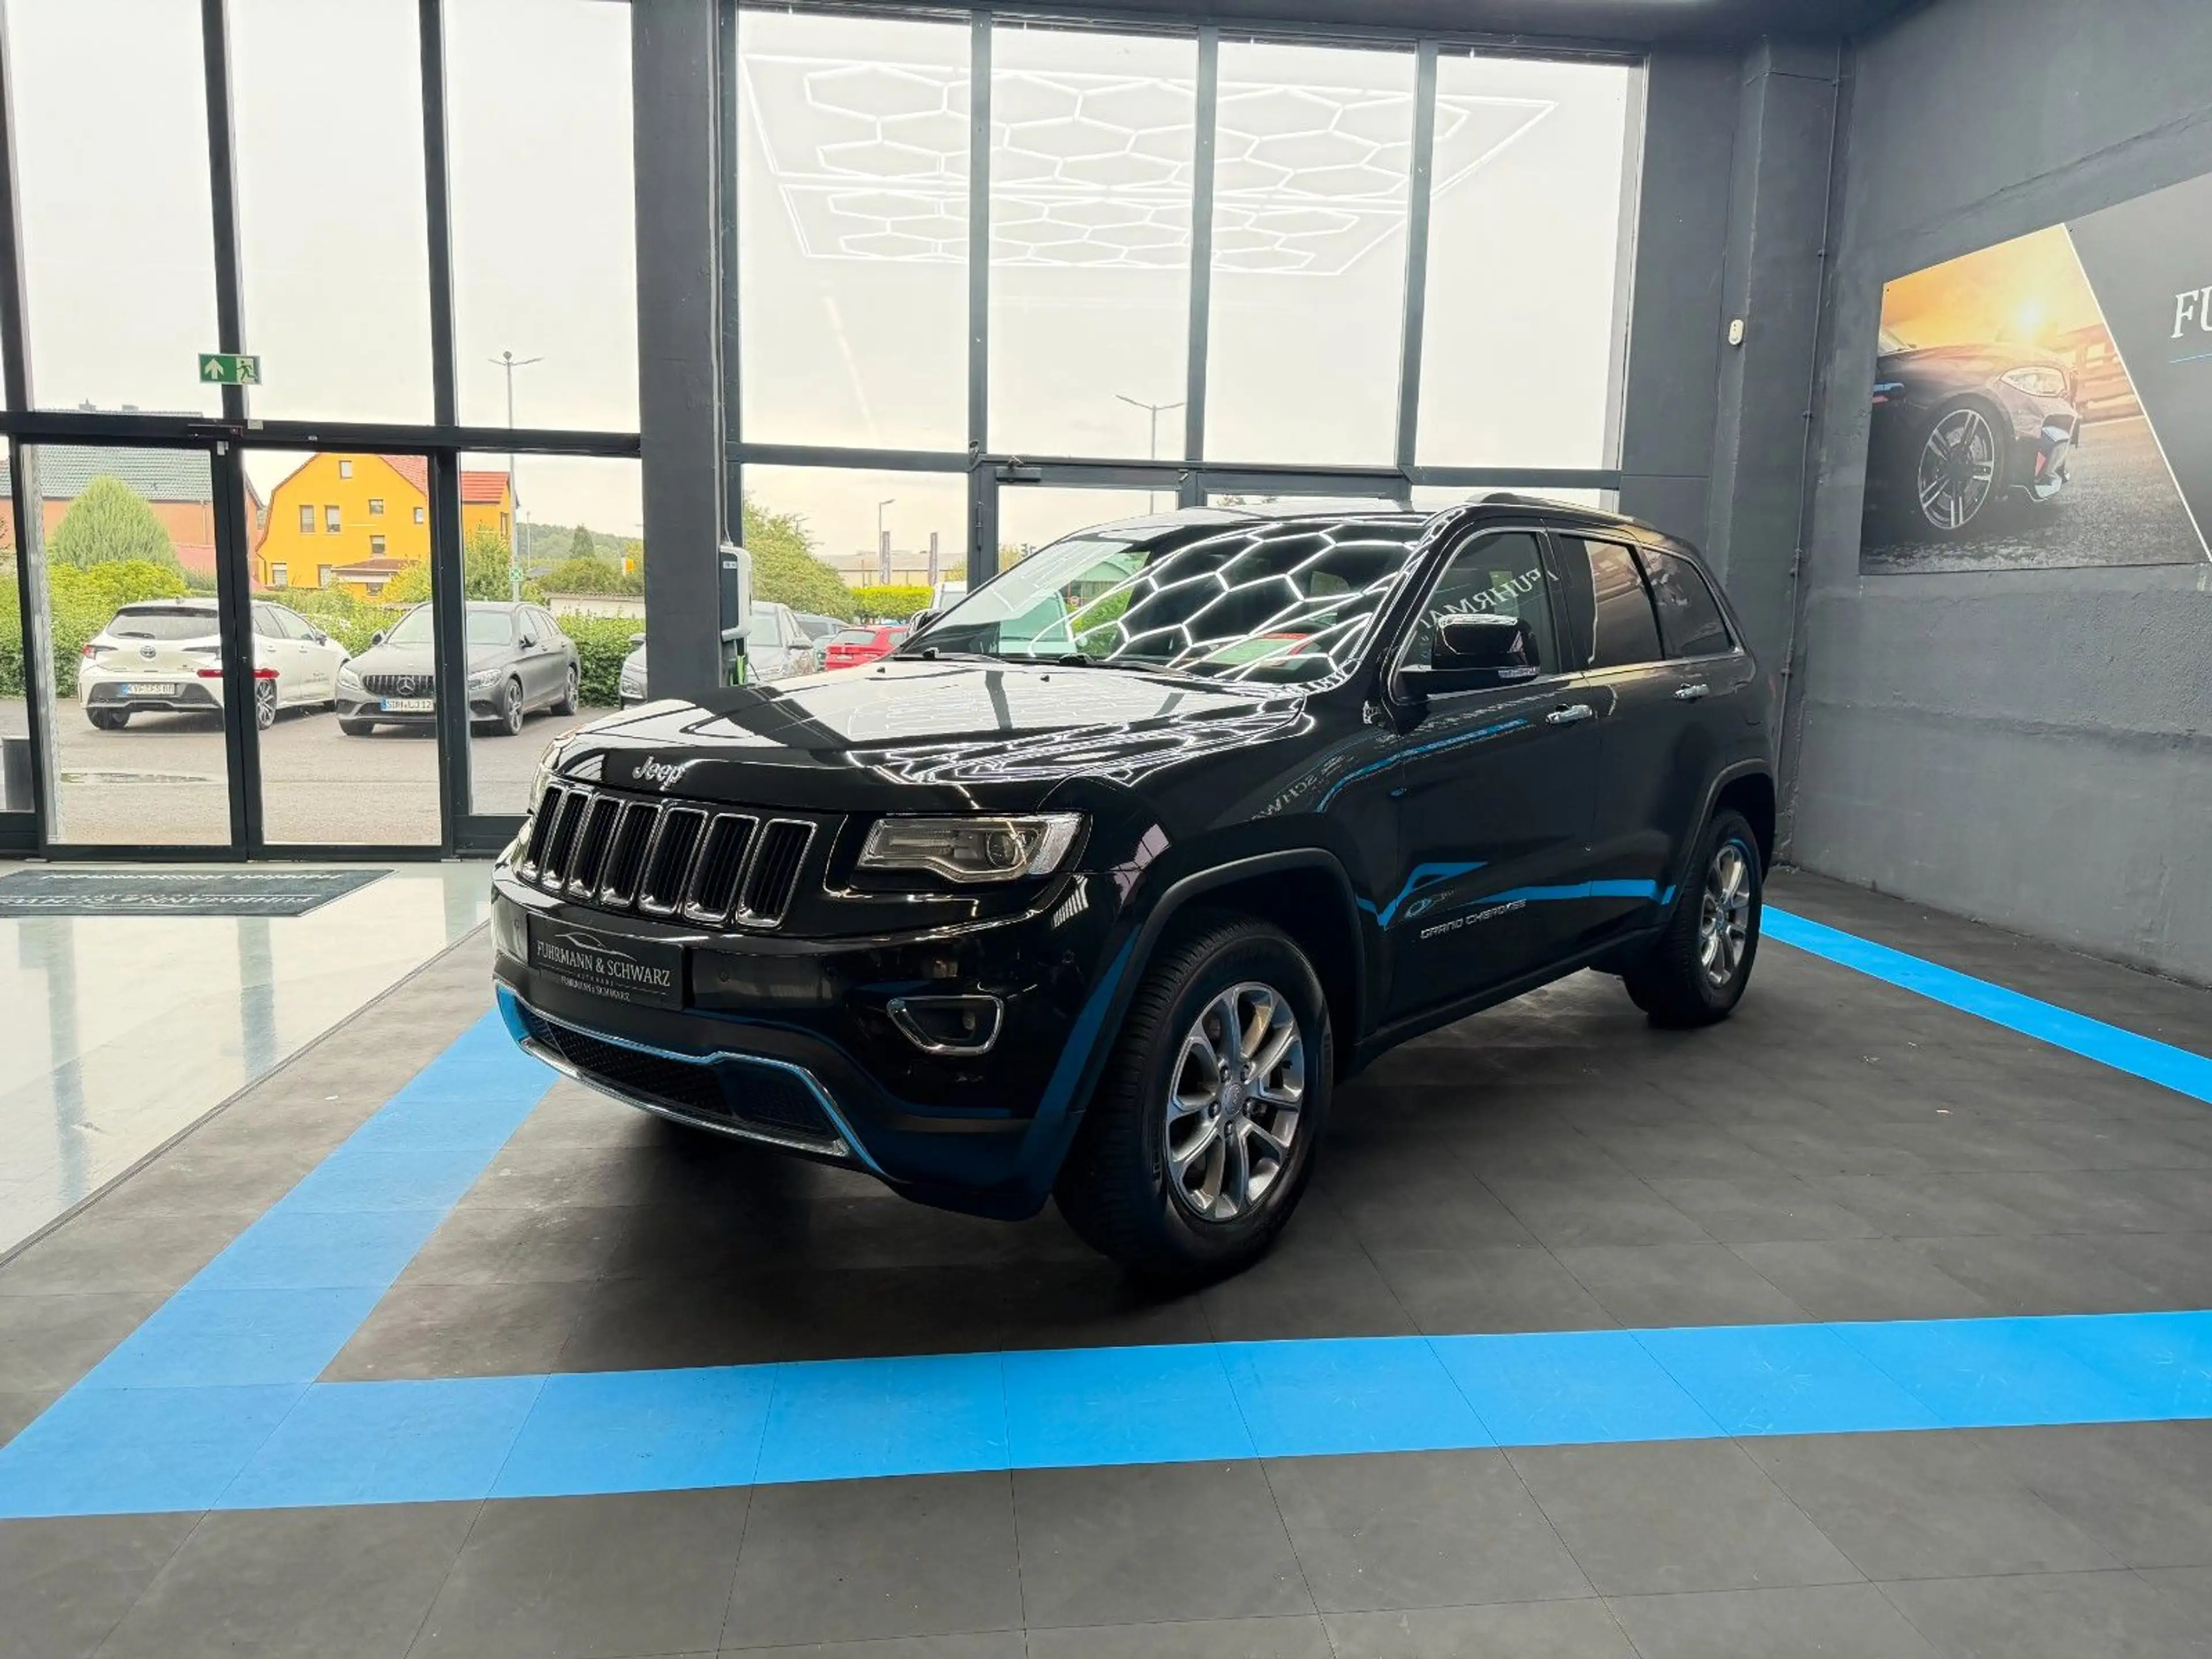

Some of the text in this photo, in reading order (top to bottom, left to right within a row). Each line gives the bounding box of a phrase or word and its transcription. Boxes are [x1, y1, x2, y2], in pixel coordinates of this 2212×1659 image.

[632, 756, 685, 791] Jeep
[1420, 899, 1527, 940] GRAND CHEROKEE
[537, 940, 671, 987] FUHRMANN & SCHWARZ
